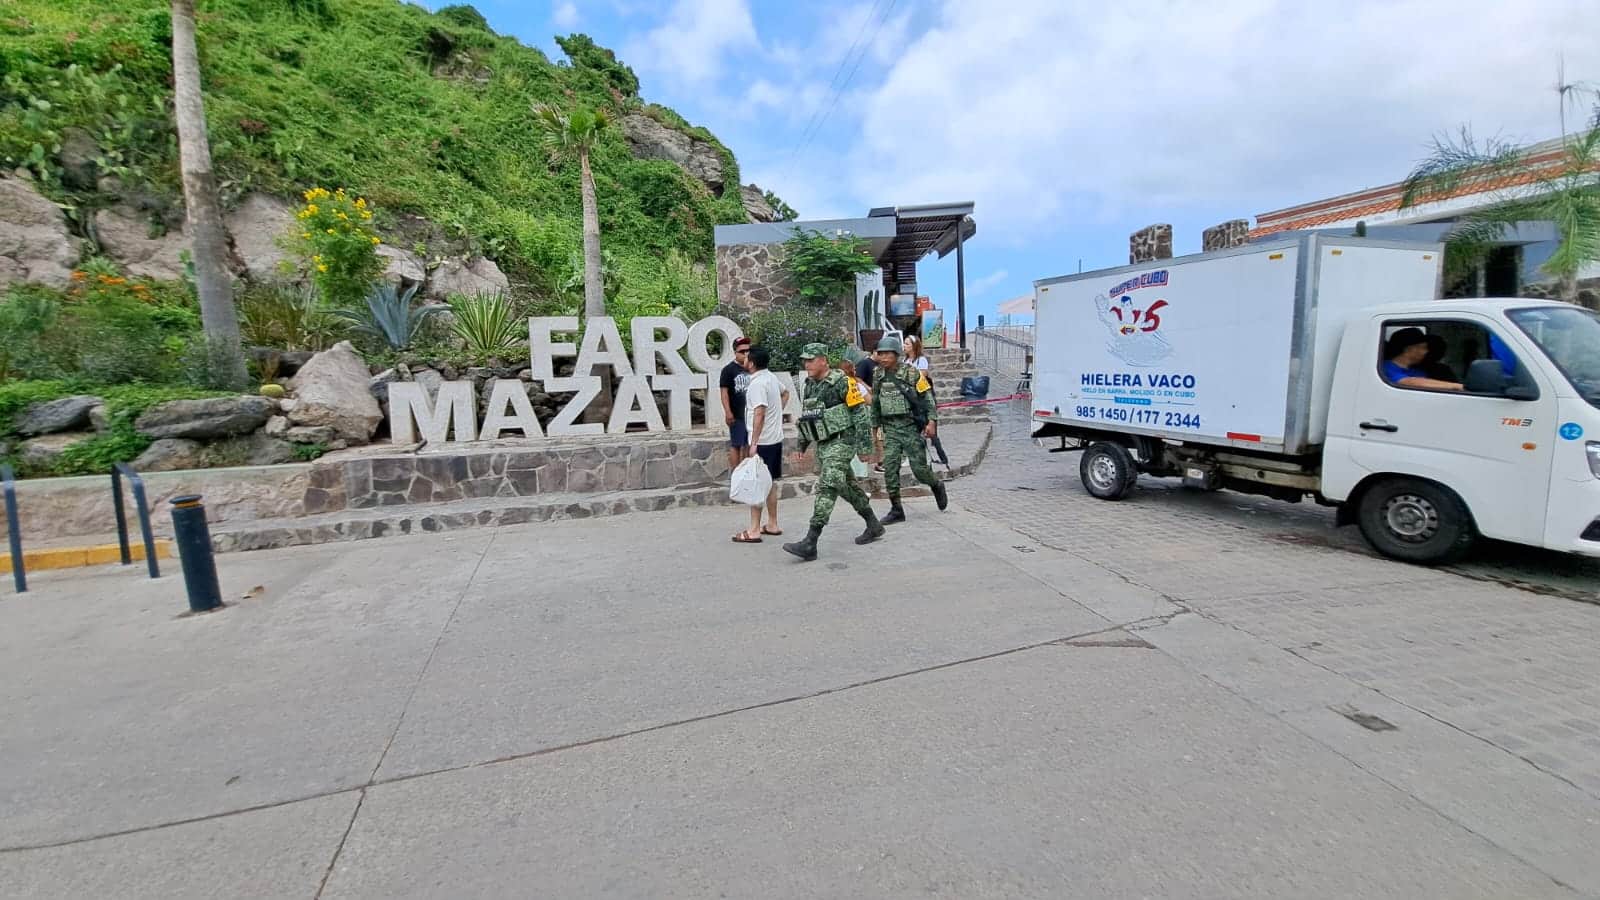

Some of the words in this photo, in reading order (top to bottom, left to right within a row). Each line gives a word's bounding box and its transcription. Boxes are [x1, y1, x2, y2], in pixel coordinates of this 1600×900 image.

[1141, 270, 1169, 288] CUBO
[529, 316, 743, 380] FARO
[1081, 373, 1142, 387] HIELERA
[1148, 374, 1195, 388] VACO
[1076, 405, 1096, 418] 985
[1100, 407, 1127, 421] 1450
[1136, 410, 1160, 424] 177
[1165, 412, 1200, 429] 2344
[1564, 427, 1578, 437] 12
